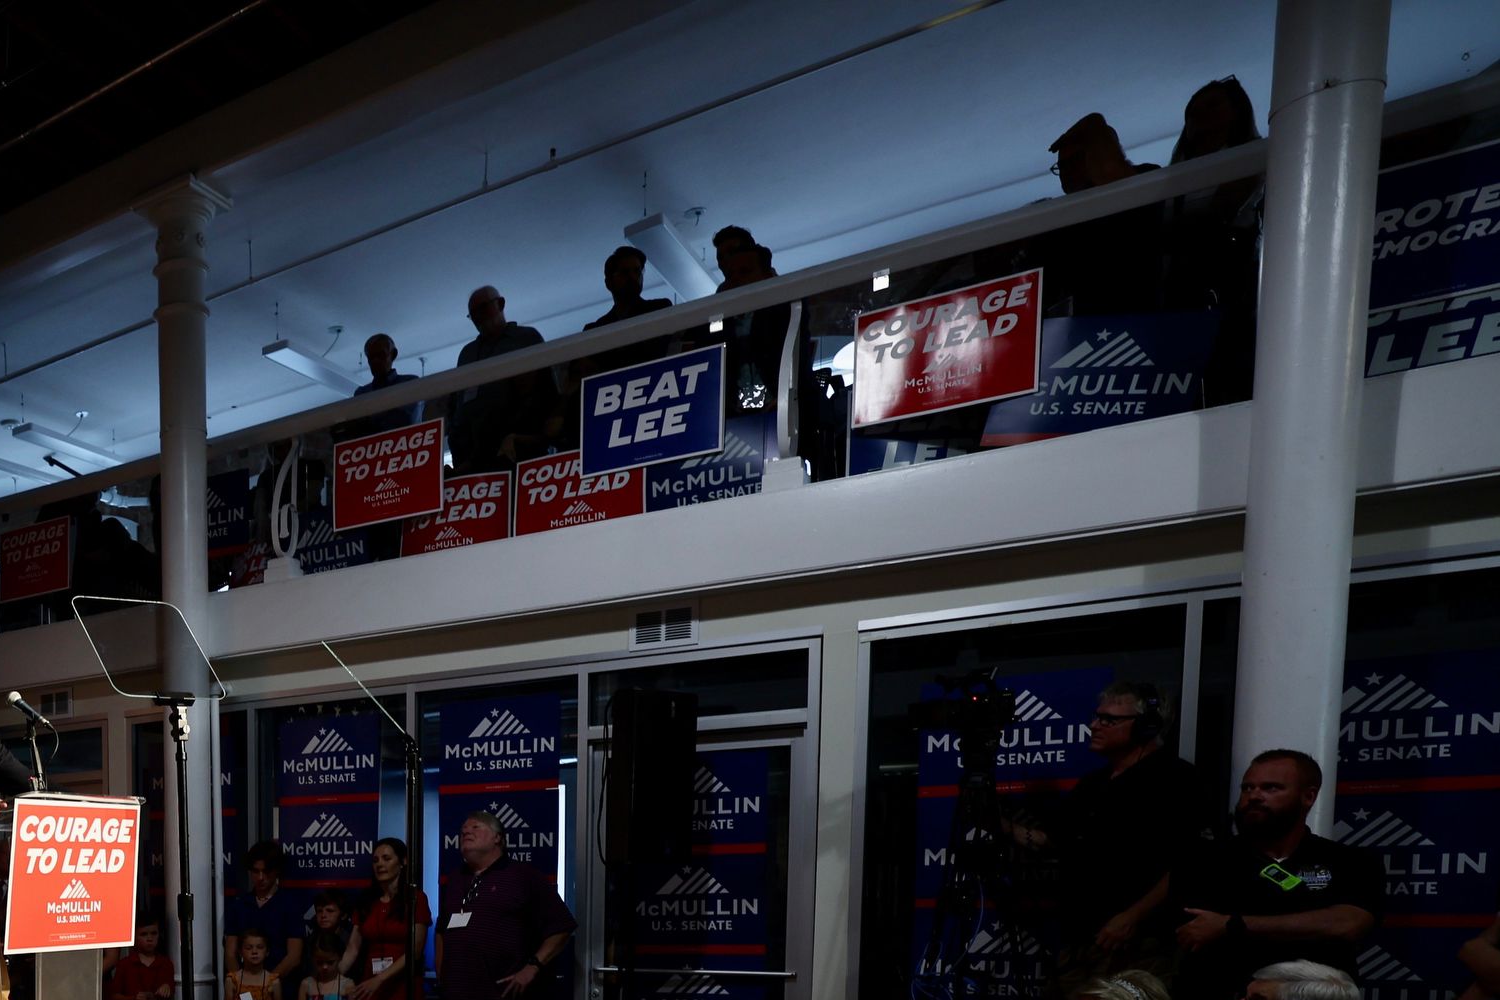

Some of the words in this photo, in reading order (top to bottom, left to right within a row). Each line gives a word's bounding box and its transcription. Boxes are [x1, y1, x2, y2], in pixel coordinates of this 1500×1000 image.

[1375, 182, 1500, 236] ROTE
[862, 283, 1032, 342] COURAGE
[873, 340, 919, 364] TO
[921, 313, 1019, 353] LEAD
[904, 363, 982, 388] McMULLIN
[1039, 372, 1193, 397] cMULLIN
[594, 362, 709, 416] BEAT
[1029, 401, 1064, 416] U.S.
[1071, 401, 1145, 415] SENATE
[608, 403, 690, 448] LEE
[338, 428, 438, 465] COURAGE
[344, 464, 369, 483] TO
[374, 450, 430, 477] LEAD
[521, 459, 581, 486] COUR
[444, 480, 505, 503] RAGE
[528, 484, 558, 505] TO
[563, 471, 630, 499] LEAD
[652, 461, 760, 498] McMULL
[363, 487, 410, 504] McMULLIN
[435, 502, 496, 526] LEAD
[550, 511, 606, 528] McMULLIN
[2, 523, 67, 551] COURAGE
[424, 537, 473, 552] McMULLIN
[6, 550, 22, 565] TO
[25, 540, 61, 560] LEAD
[300, 539, 365, 567] MULLIN
[927, 723, 1092, 753] McULLIN
[1339, 711, 1500, 743] MULLIN
[444, 736, 555, 760] McMULLIN
[997, 750, 1066, 766] SENATE
[1358, 744, 1452, 762] SENATE
[283, 753, 375, 774] McMULLIN
[464, 759, 485, 771] U.S.
[489, 758, 533, 770] SENATE
[298, 775, 317, 785] U.S.
[319, 773, 356, 784] SENATE
[19, 815, 134, 843] COURAGE
[692, 818, 734, 831] ENATE
[282, 840, 373, 856] McMULLIN
[444, 832, 554, 850] MLLIN
[26, 848, 58, 874] TO
[61, 848, 126, 874] LEAD
[298, 858, 316, 868] U.S.
[319, 858, 356, 868] SENATE
[1383, 852, 1487, 875] LLIN
[47, 901, 101, 914] McMULLIN
[69, 915, 91, 923] SENATE
[636, 898, 759, 917] McMULLIN
[652, 920, 676, 932] U.S.
[681, 919, 733, 932] SENATE
